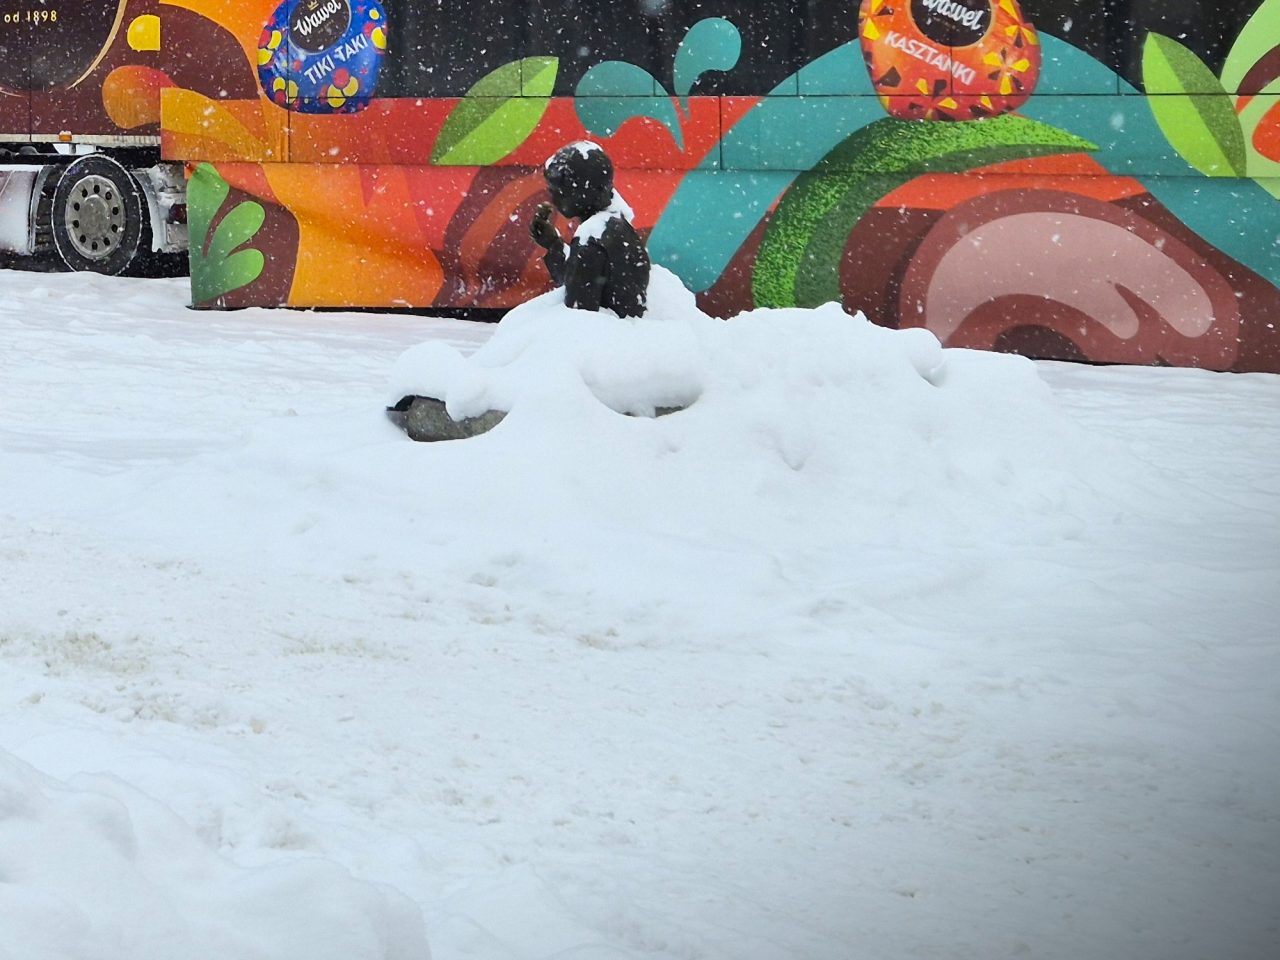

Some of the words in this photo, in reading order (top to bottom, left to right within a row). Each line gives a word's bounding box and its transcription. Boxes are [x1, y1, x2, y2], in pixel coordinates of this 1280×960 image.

[3, 12, 20, 23] od
[24, 10, 58, 23] 1898
[304, 54, 336, 85] TIKI
[334, 33, 368, 62] TAKI
[884, 31, 977, 86] KASZTANKI
